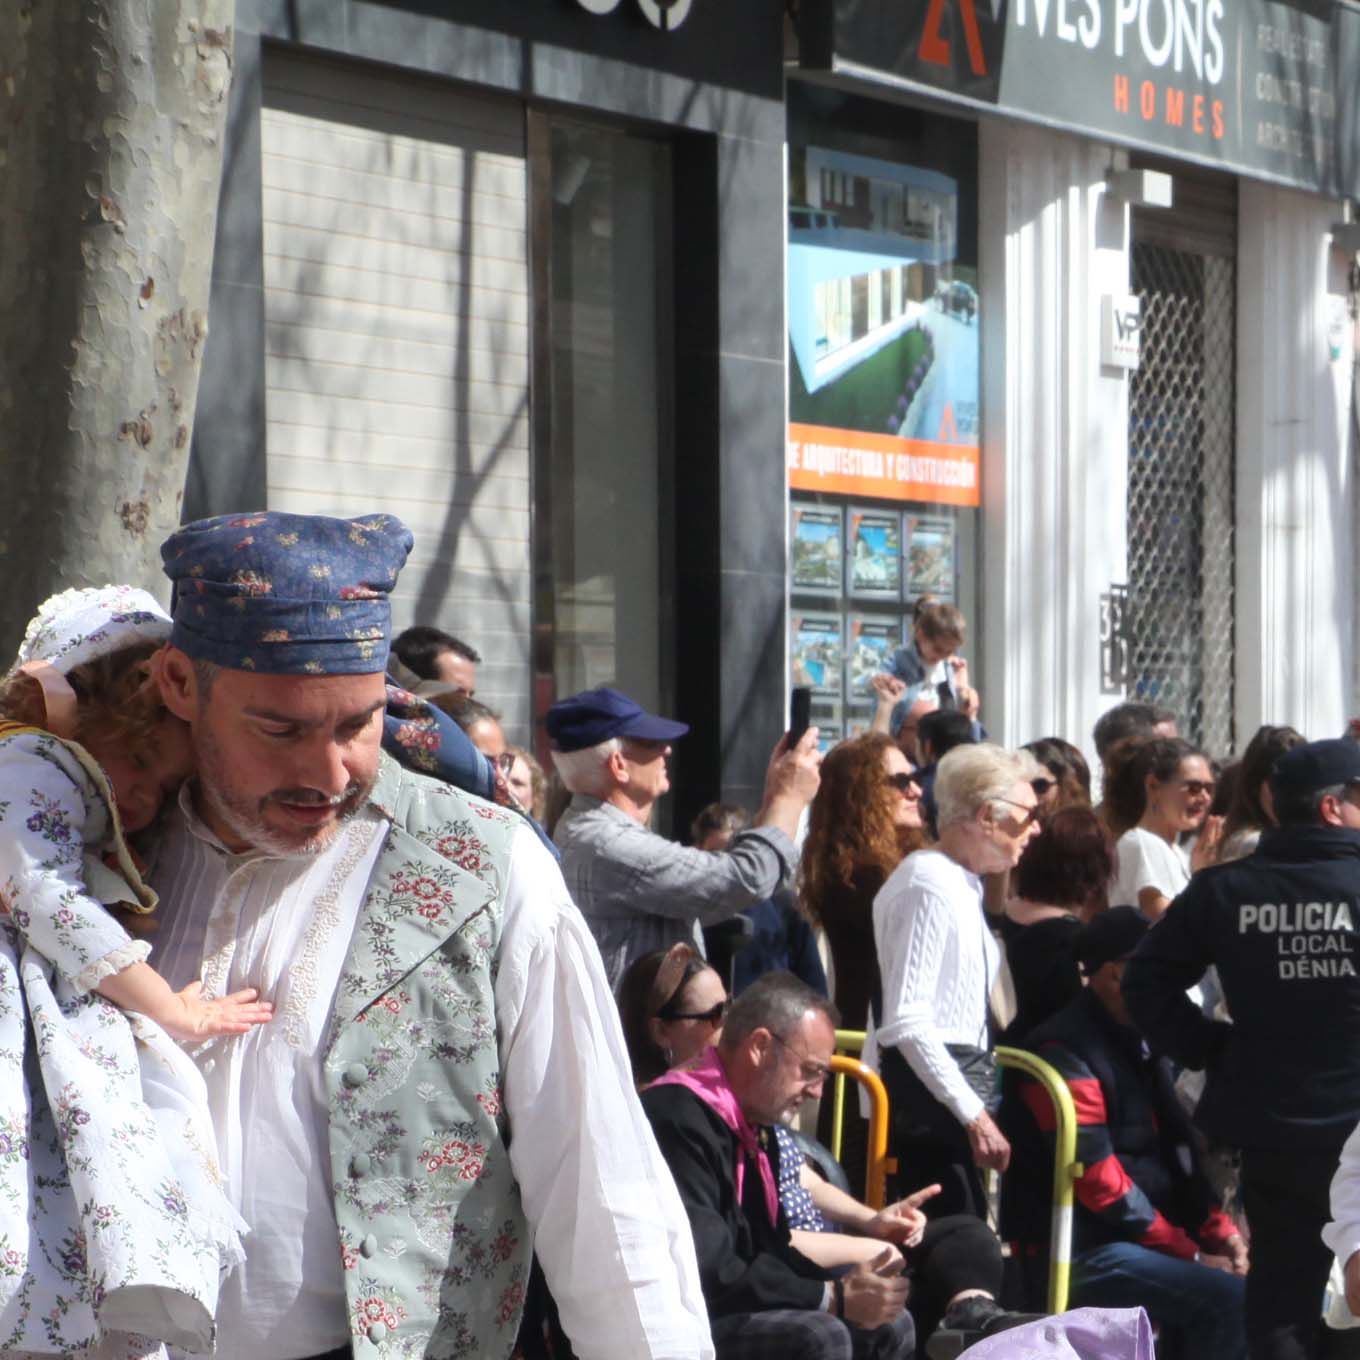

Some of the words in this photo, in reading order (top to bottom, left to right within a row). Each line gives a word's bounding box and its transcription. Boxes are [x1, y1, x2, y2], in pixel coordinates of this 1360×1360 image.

[1113, 73, 1225, 139] HOMES
[886, 452, 895, 480] Y
[896, 453, 976, 488] CONSTRUCCIÓN
[1238, 902, 1354, 935] POLICIA
[1278, 934, 1354, 955] LOCAL
[1278, 955, 1357, 980] DÉNIA
